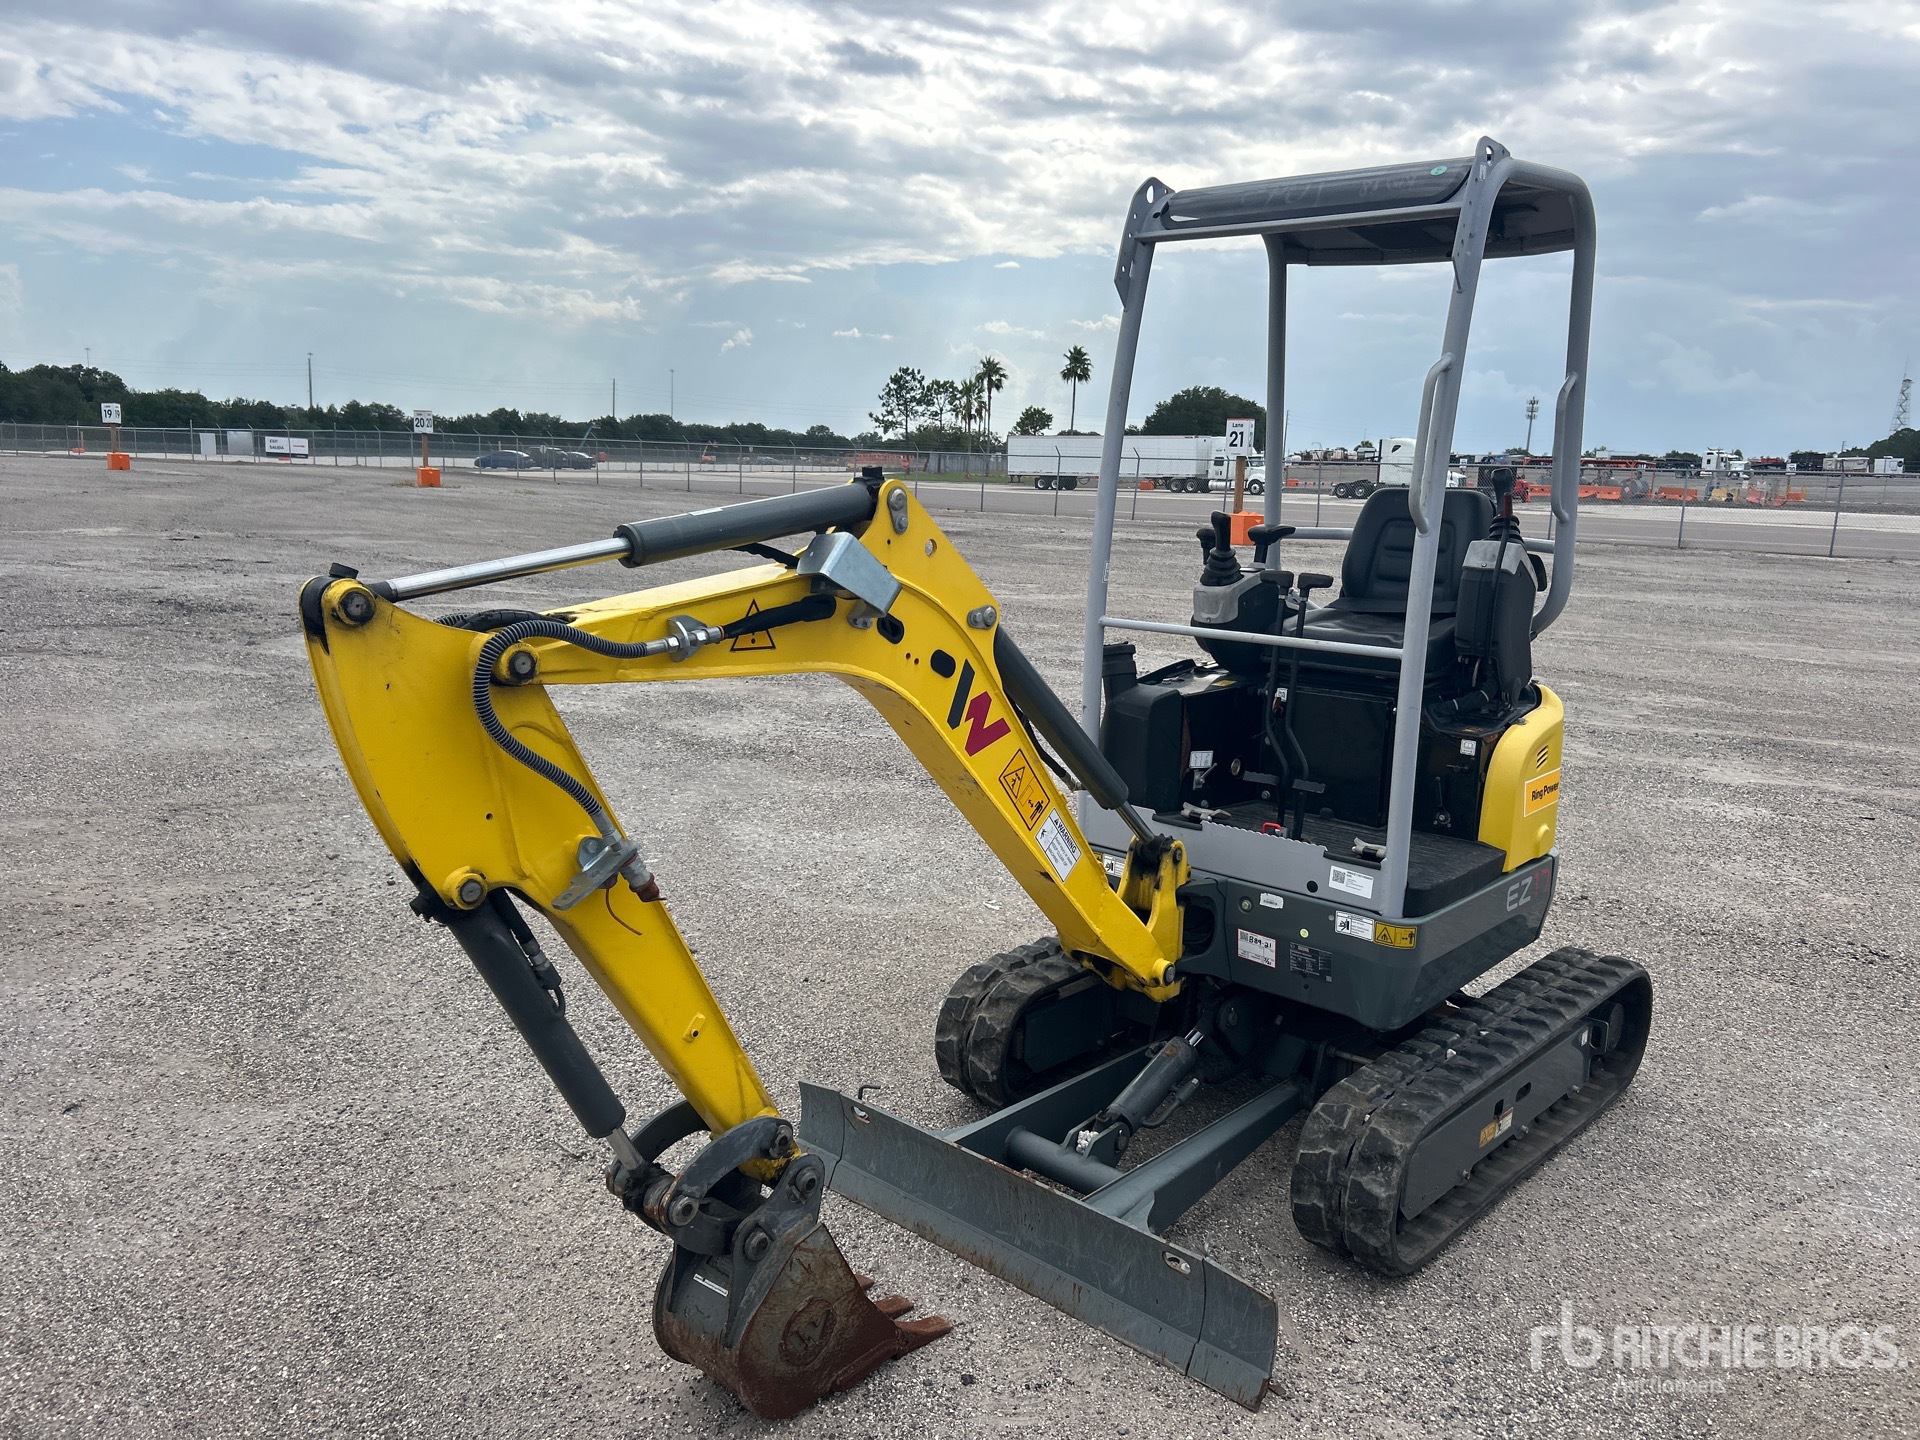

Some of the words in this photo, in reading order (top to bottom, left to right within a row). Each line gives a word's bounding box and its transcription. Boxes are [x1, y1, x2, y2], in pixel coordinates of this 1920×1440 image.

[103, 409, 112, 419] 19
[415, 417, 425, 428] 20
[1229, 430, 1244, 448] 21
[1531, 788, 1543, 802] Ring
[1543, 782, 1559, 796] Power
[1057, 823, 1077, 854] WARNING
